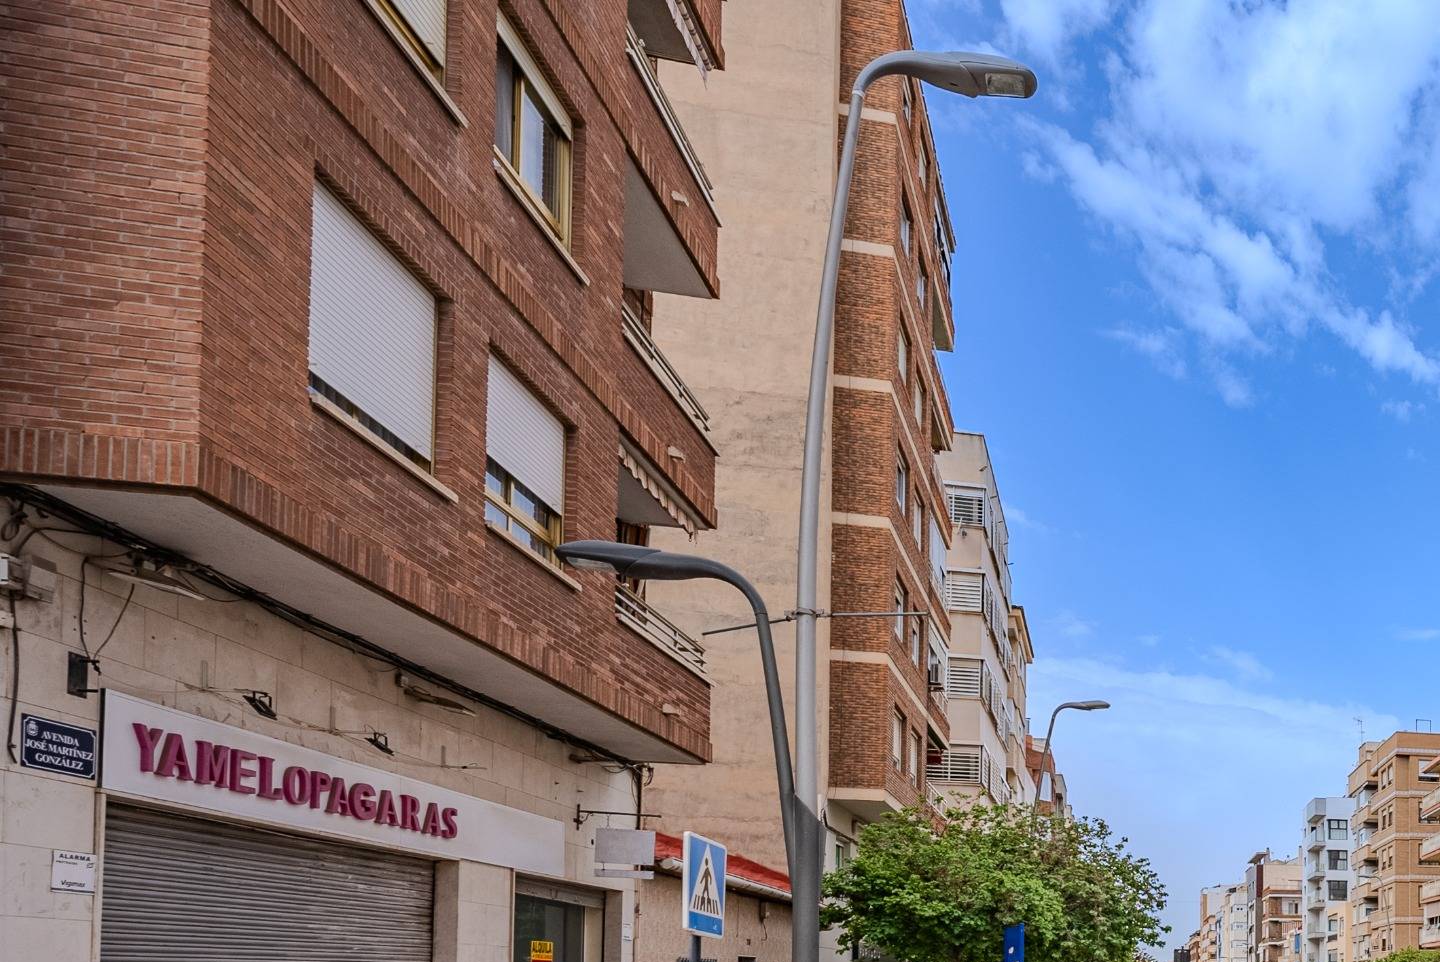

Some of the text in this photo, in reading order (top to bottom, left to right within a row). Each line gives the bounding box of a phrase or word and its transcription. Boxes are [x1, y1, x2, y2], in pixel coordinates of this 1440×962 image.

[41, 731, 80, 747] AVENIDA
[25, 738, 93, 761] JOSÉ MARTÍNEZ
[35, 752, 84, 770] GONZÁLEZ
[132, 723, 458, 838] YAMELOPAGARAS
[59, 853, 91, 861] ALARMA
